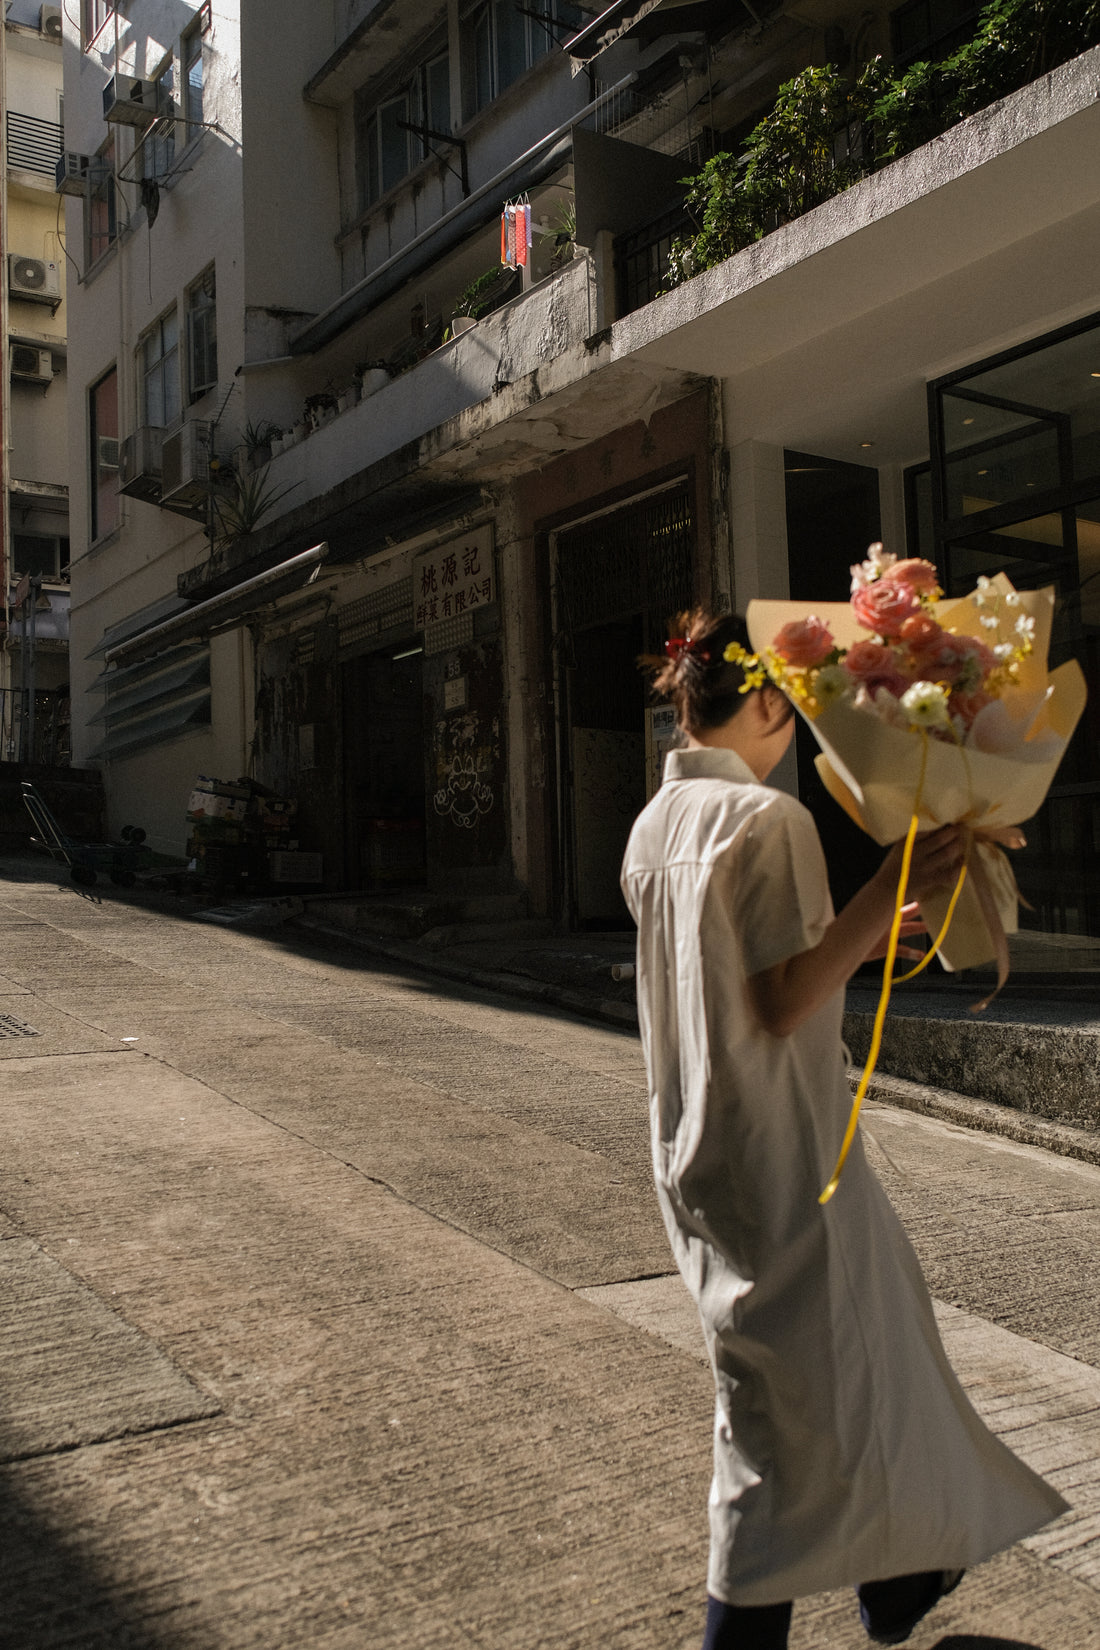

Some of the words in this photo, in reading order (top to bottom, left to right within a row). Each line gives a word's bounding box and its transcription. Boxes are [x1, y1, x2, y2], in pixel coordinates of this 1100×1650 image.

[421, 546, 480, 597] 桃源記
[448, 660, 460, 677] 55
